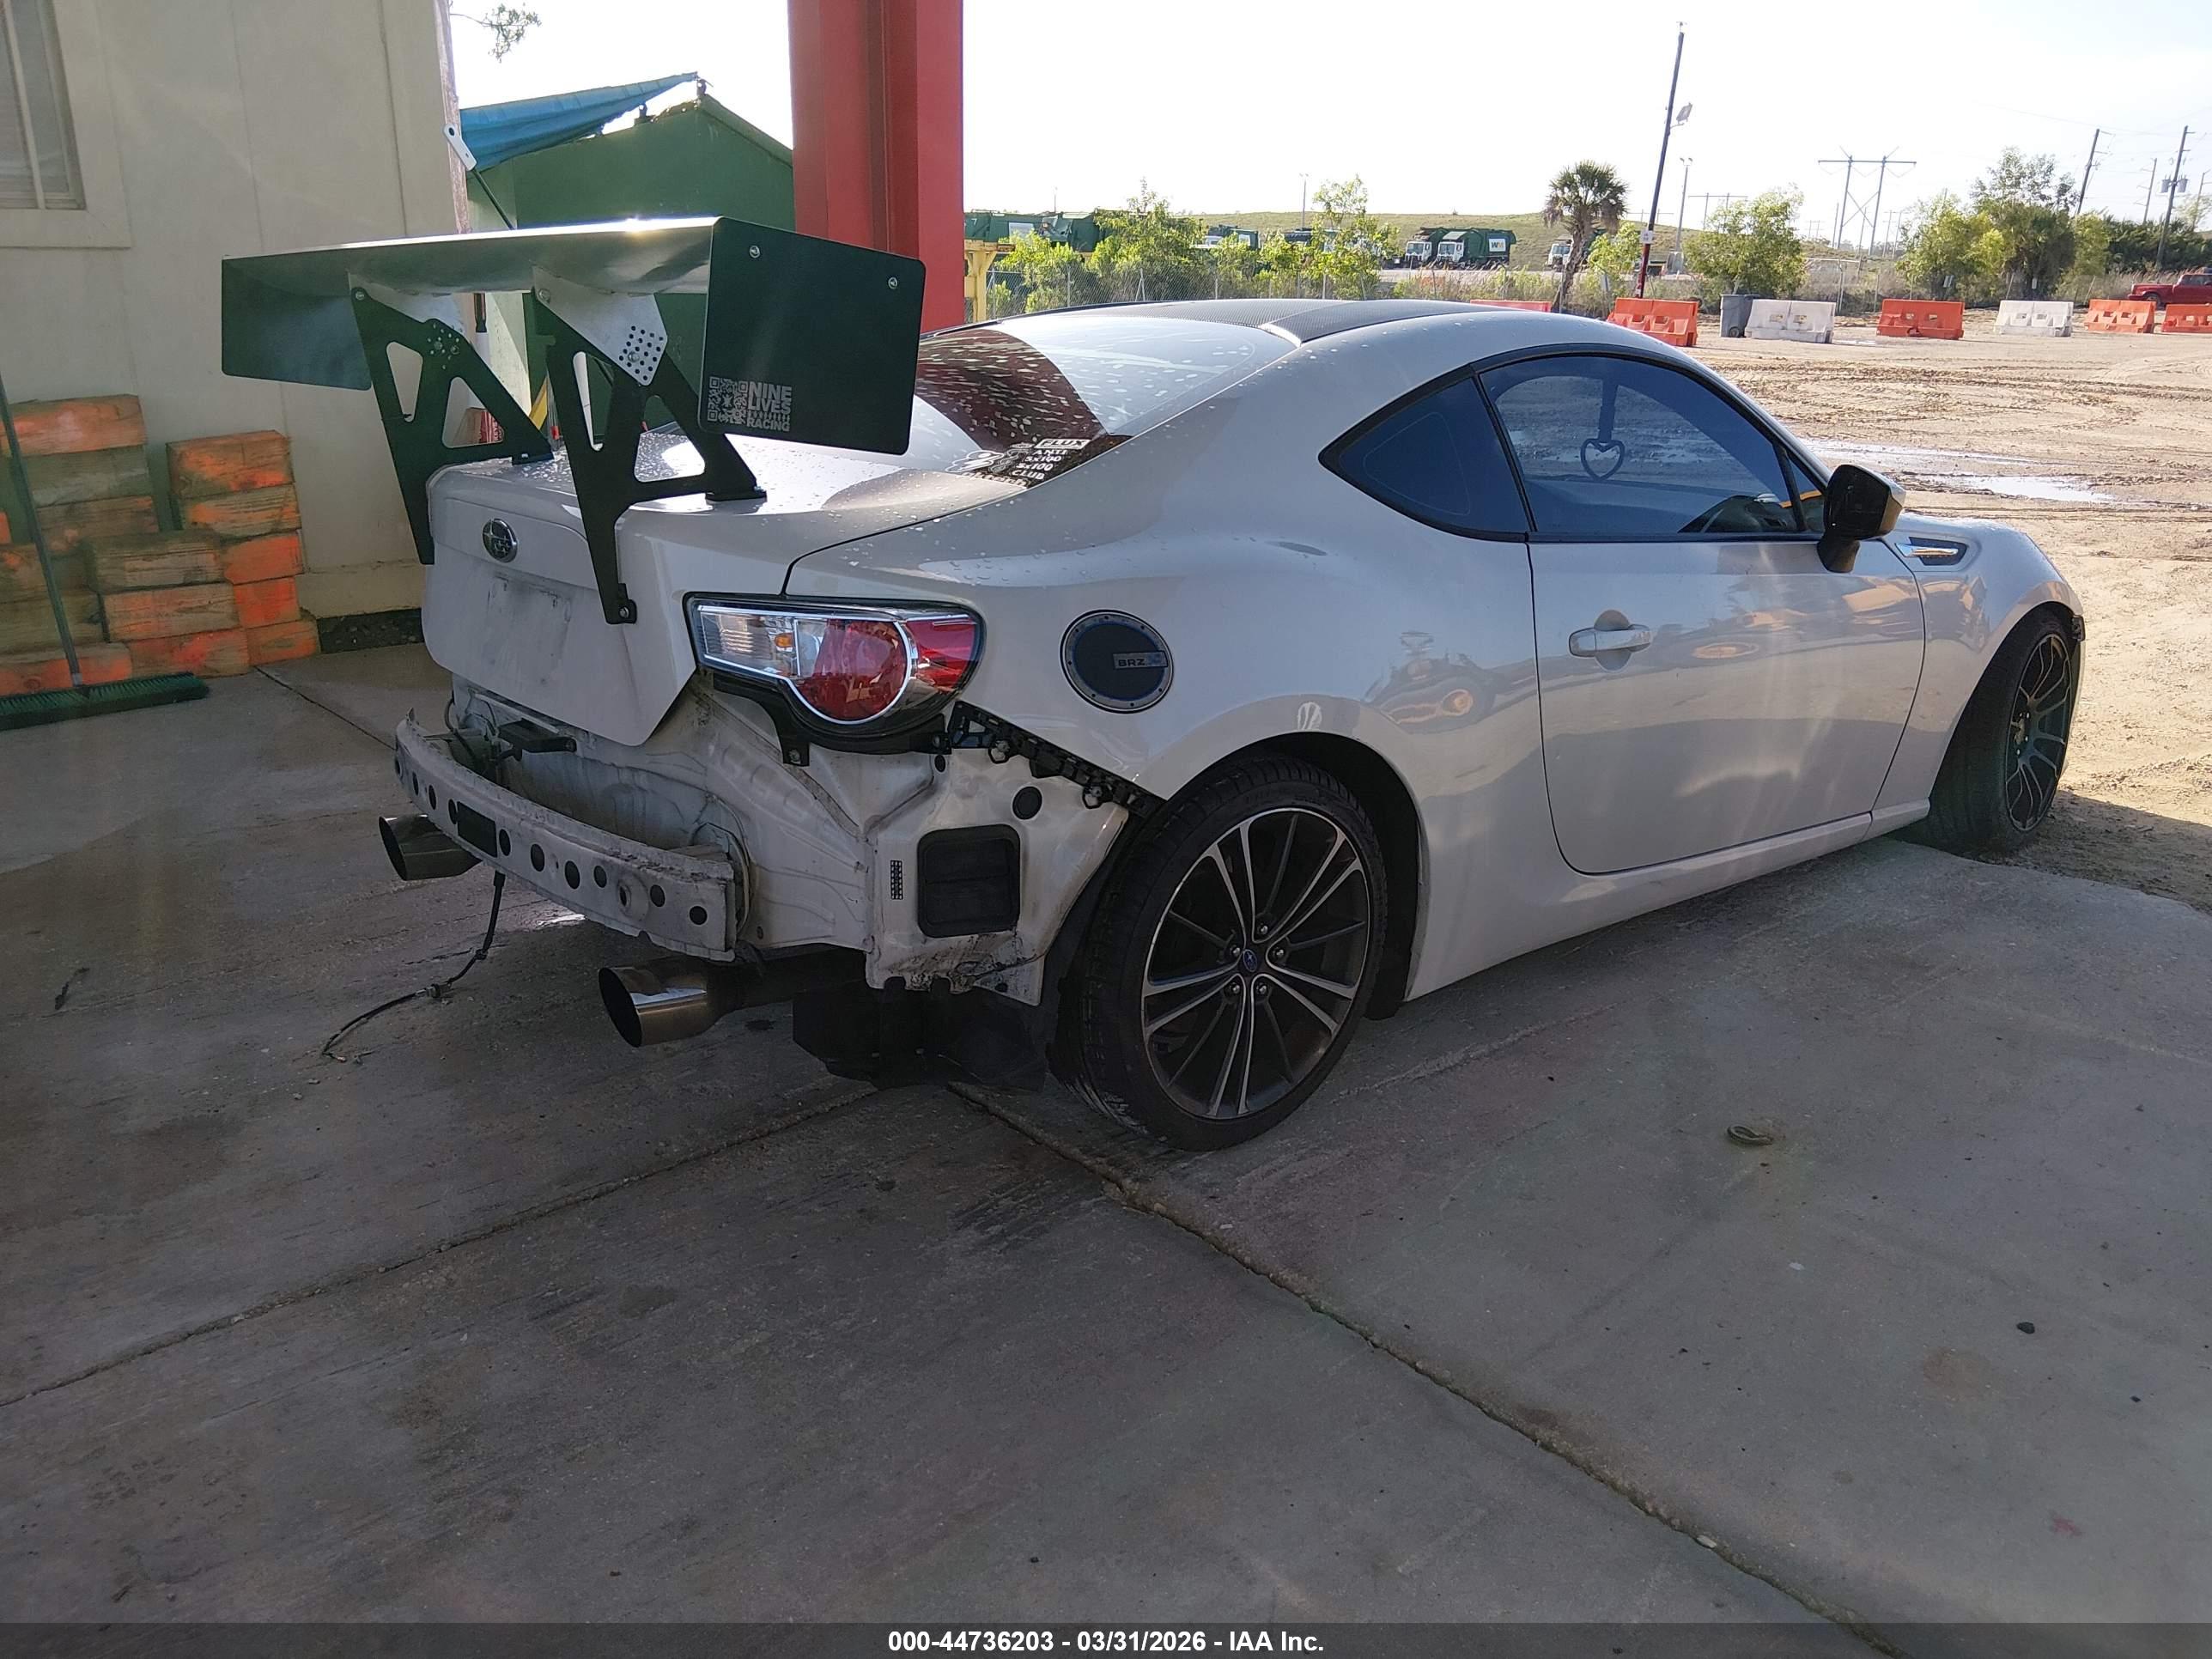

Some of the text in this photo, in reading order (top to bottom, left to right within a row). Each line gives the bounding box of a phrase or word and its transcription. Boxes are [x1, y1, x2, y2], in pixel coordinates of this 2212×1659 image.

[749, 381, 793, 400] NINE
[748, 396, 792, 415] LIVES
[747, 417, 791, 432] RACING
[1012, 470, 1045, 480] CLUB
[1118, 659, 1146, 667] BRZ
